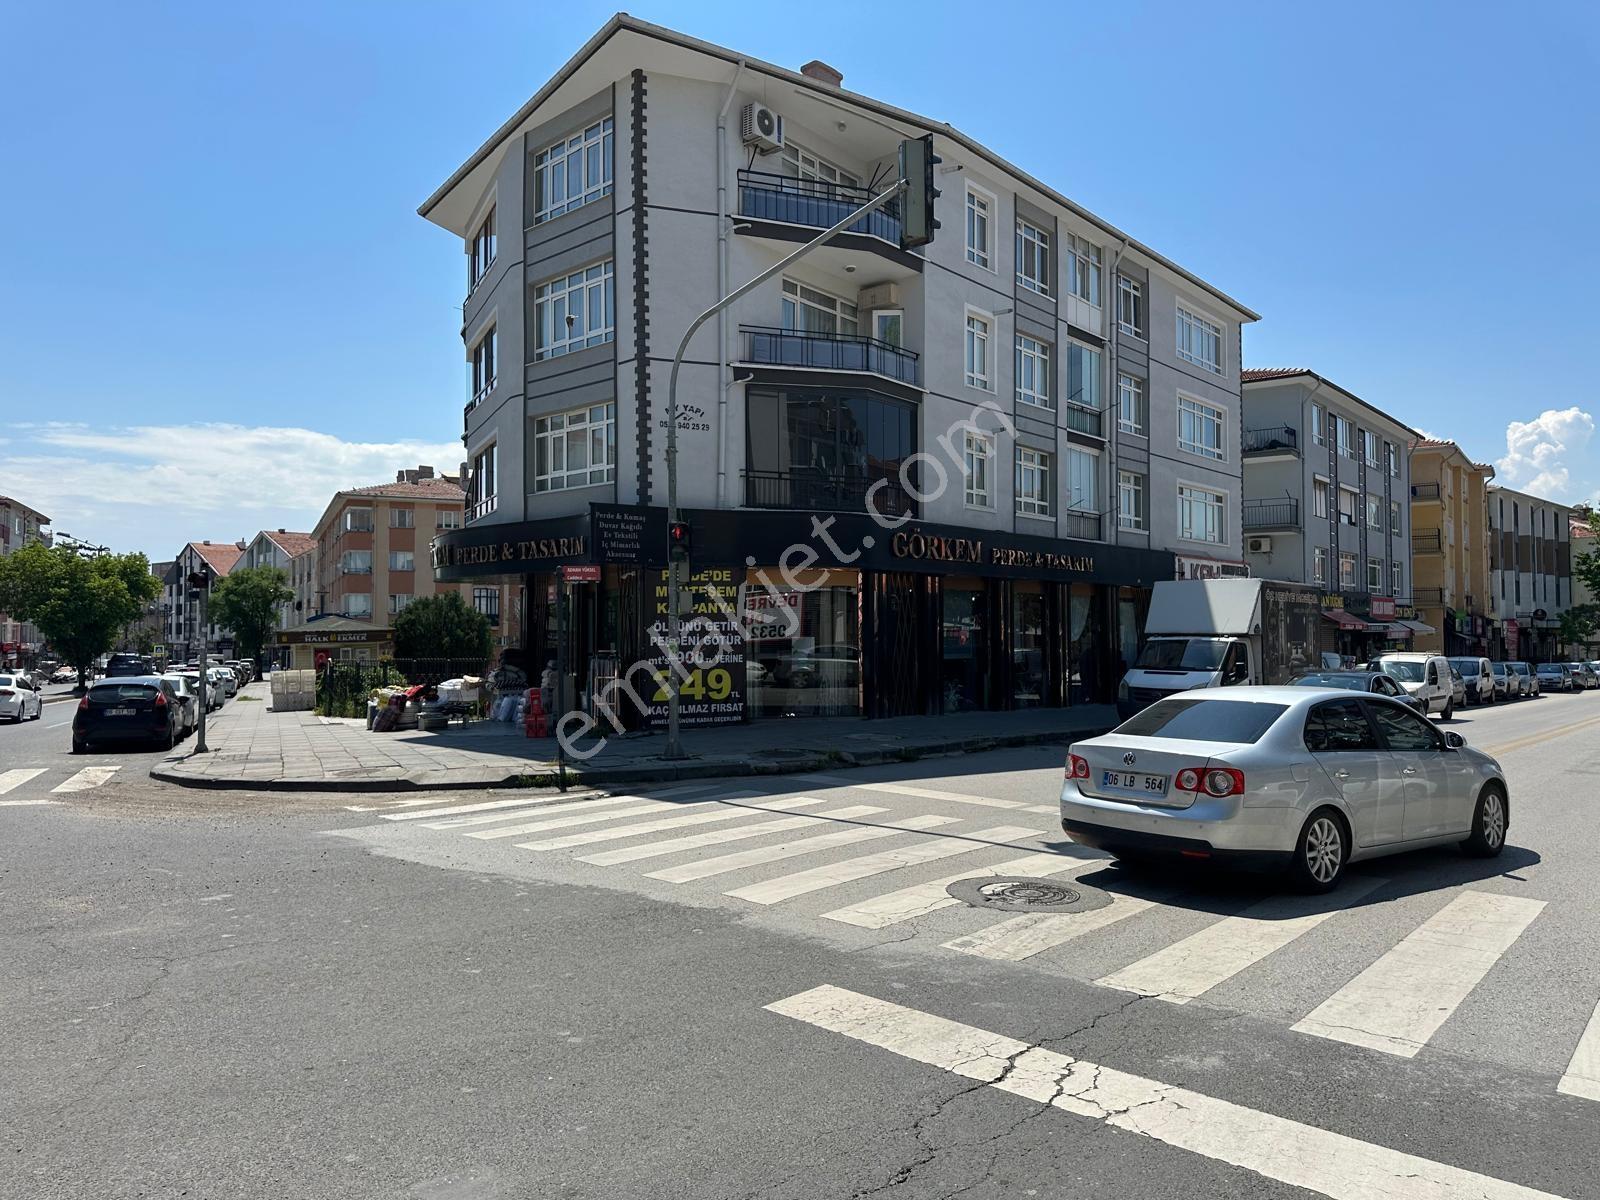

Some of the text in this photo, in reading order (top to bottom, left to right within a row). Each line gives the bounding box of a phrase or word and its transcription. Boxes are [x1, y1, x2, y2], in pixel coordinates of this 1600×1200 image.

[683, 404, 705, 417] YAPI
[595, 511, 615, 520] Perde
[616, 512, 622, 520] &
[599, 521, 619, 529] Duvar
[457, 544, 498, 565] PERDE
[501, 542, 514, 561] &
[518, 536, 585, 560] TASARIM
[892, 527, 1095, 573] GÖRKEM PERDE & TASARIM
[653, 620, 702, 632] ÖLÜNÜ
[704, 620, 739, 632] GETİR
[703, 635, 742, 646] GÖTÜR
[714, 653, 744, 664] YERİNE
[648, 702, 744, 717] KAÇILMAZ FIRSAT
[1108, 773, 1163, 790] 06 LB 564
